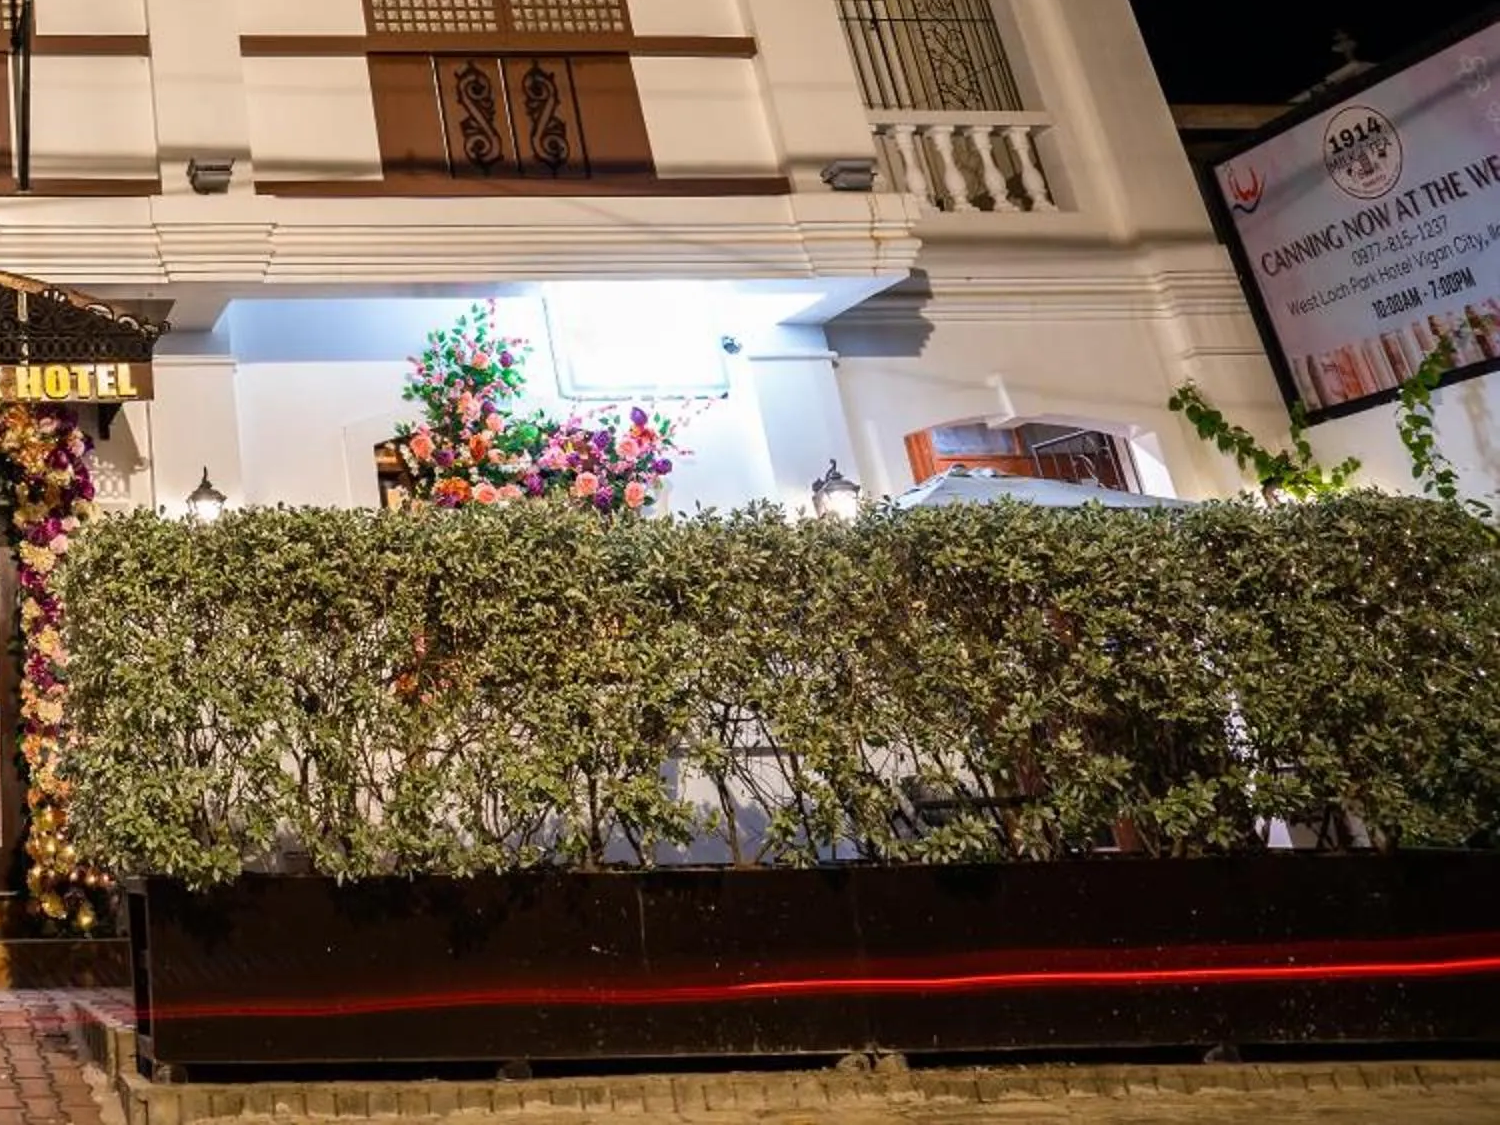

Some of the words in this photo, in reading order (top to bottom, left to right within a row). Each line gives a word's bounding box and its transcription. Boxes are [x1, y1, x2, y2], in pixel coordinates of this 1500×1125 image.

[1328, 117, 1382, 154] 1914
[1261, 224, 1345, 276] CANNING
[1342, 202, 1391, 242] NOW
[1396, 190, 1421, 223] AT
[1420, 171, 1468, 208] THE
[1286, 294, 1319, 316] West
[1317, 282, 1350, 306] Loch
[1349, 269, 1378, 294] Park
[1376, 255, 1413, 283] Hotel
[1412, 244, 1454, 270] Vigan
[1428, 266, 1477, 300] 7:00PM
[14, 362, 138, 399] HOTEL
